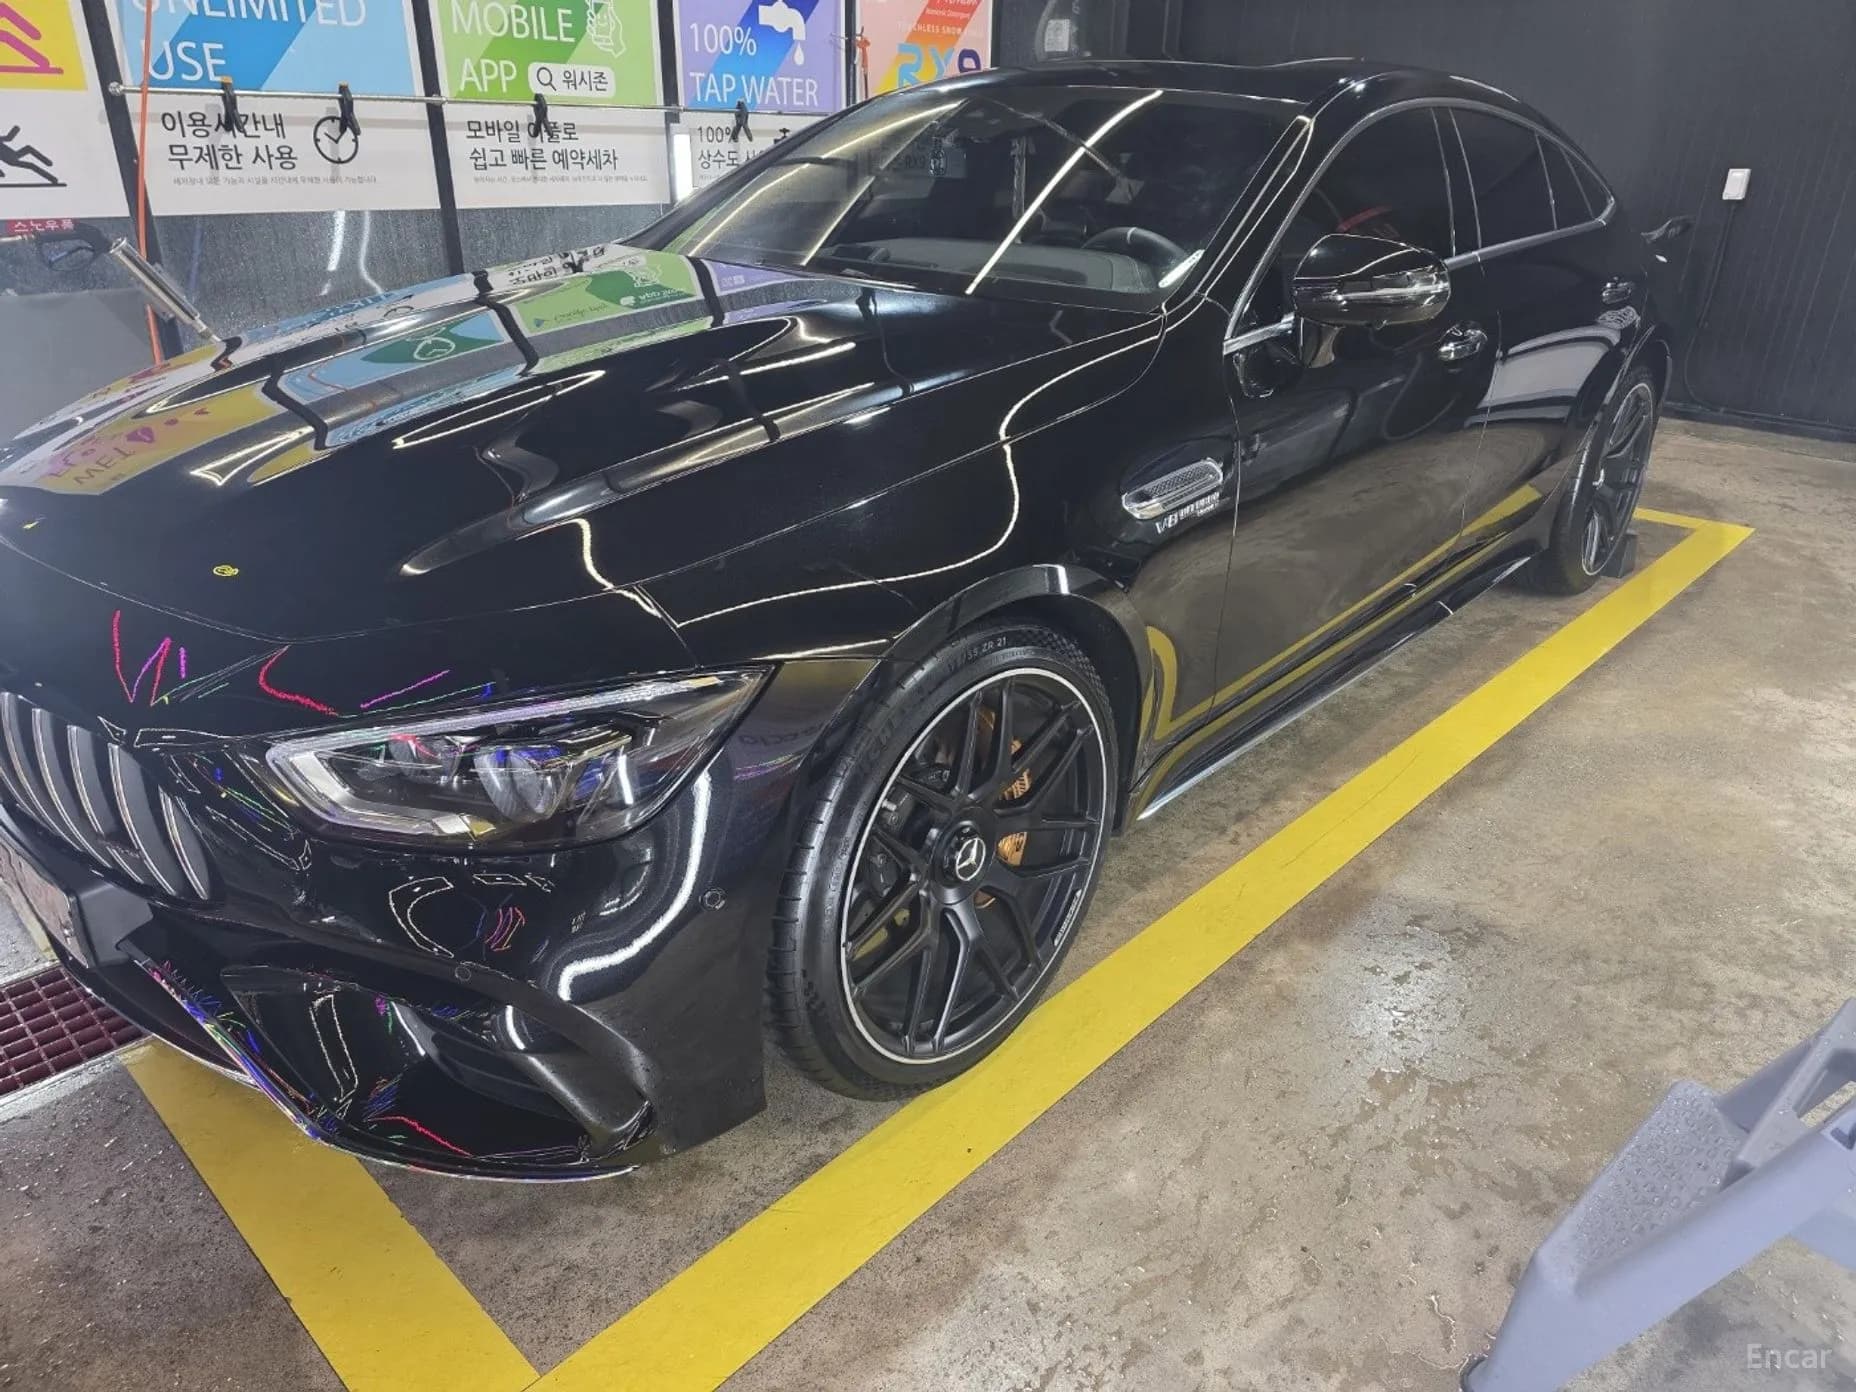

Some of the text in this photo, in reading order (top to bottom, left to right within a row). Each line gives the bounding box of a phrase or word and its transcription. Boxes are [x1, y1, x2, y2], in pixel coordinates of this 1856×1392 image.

[132, 0, 366, 26] IMITED
[452, 1, 576, 42] MOBILE
[690, 23, 757, 56] 100%
[140, 39, 226, 82] USE
[460, 58, 517, 93] APP
[562, 70, 609, 92] 워시존
[689, 72, 819, 107] TAP WATER
[466, 120, 520, 143] 모바일
[168, 144, 298, 170] 무제한 사용
[469, 147, 618, 171] 쉽고 빠른 예약세차
[698, 149, 740, 169] 상수도
